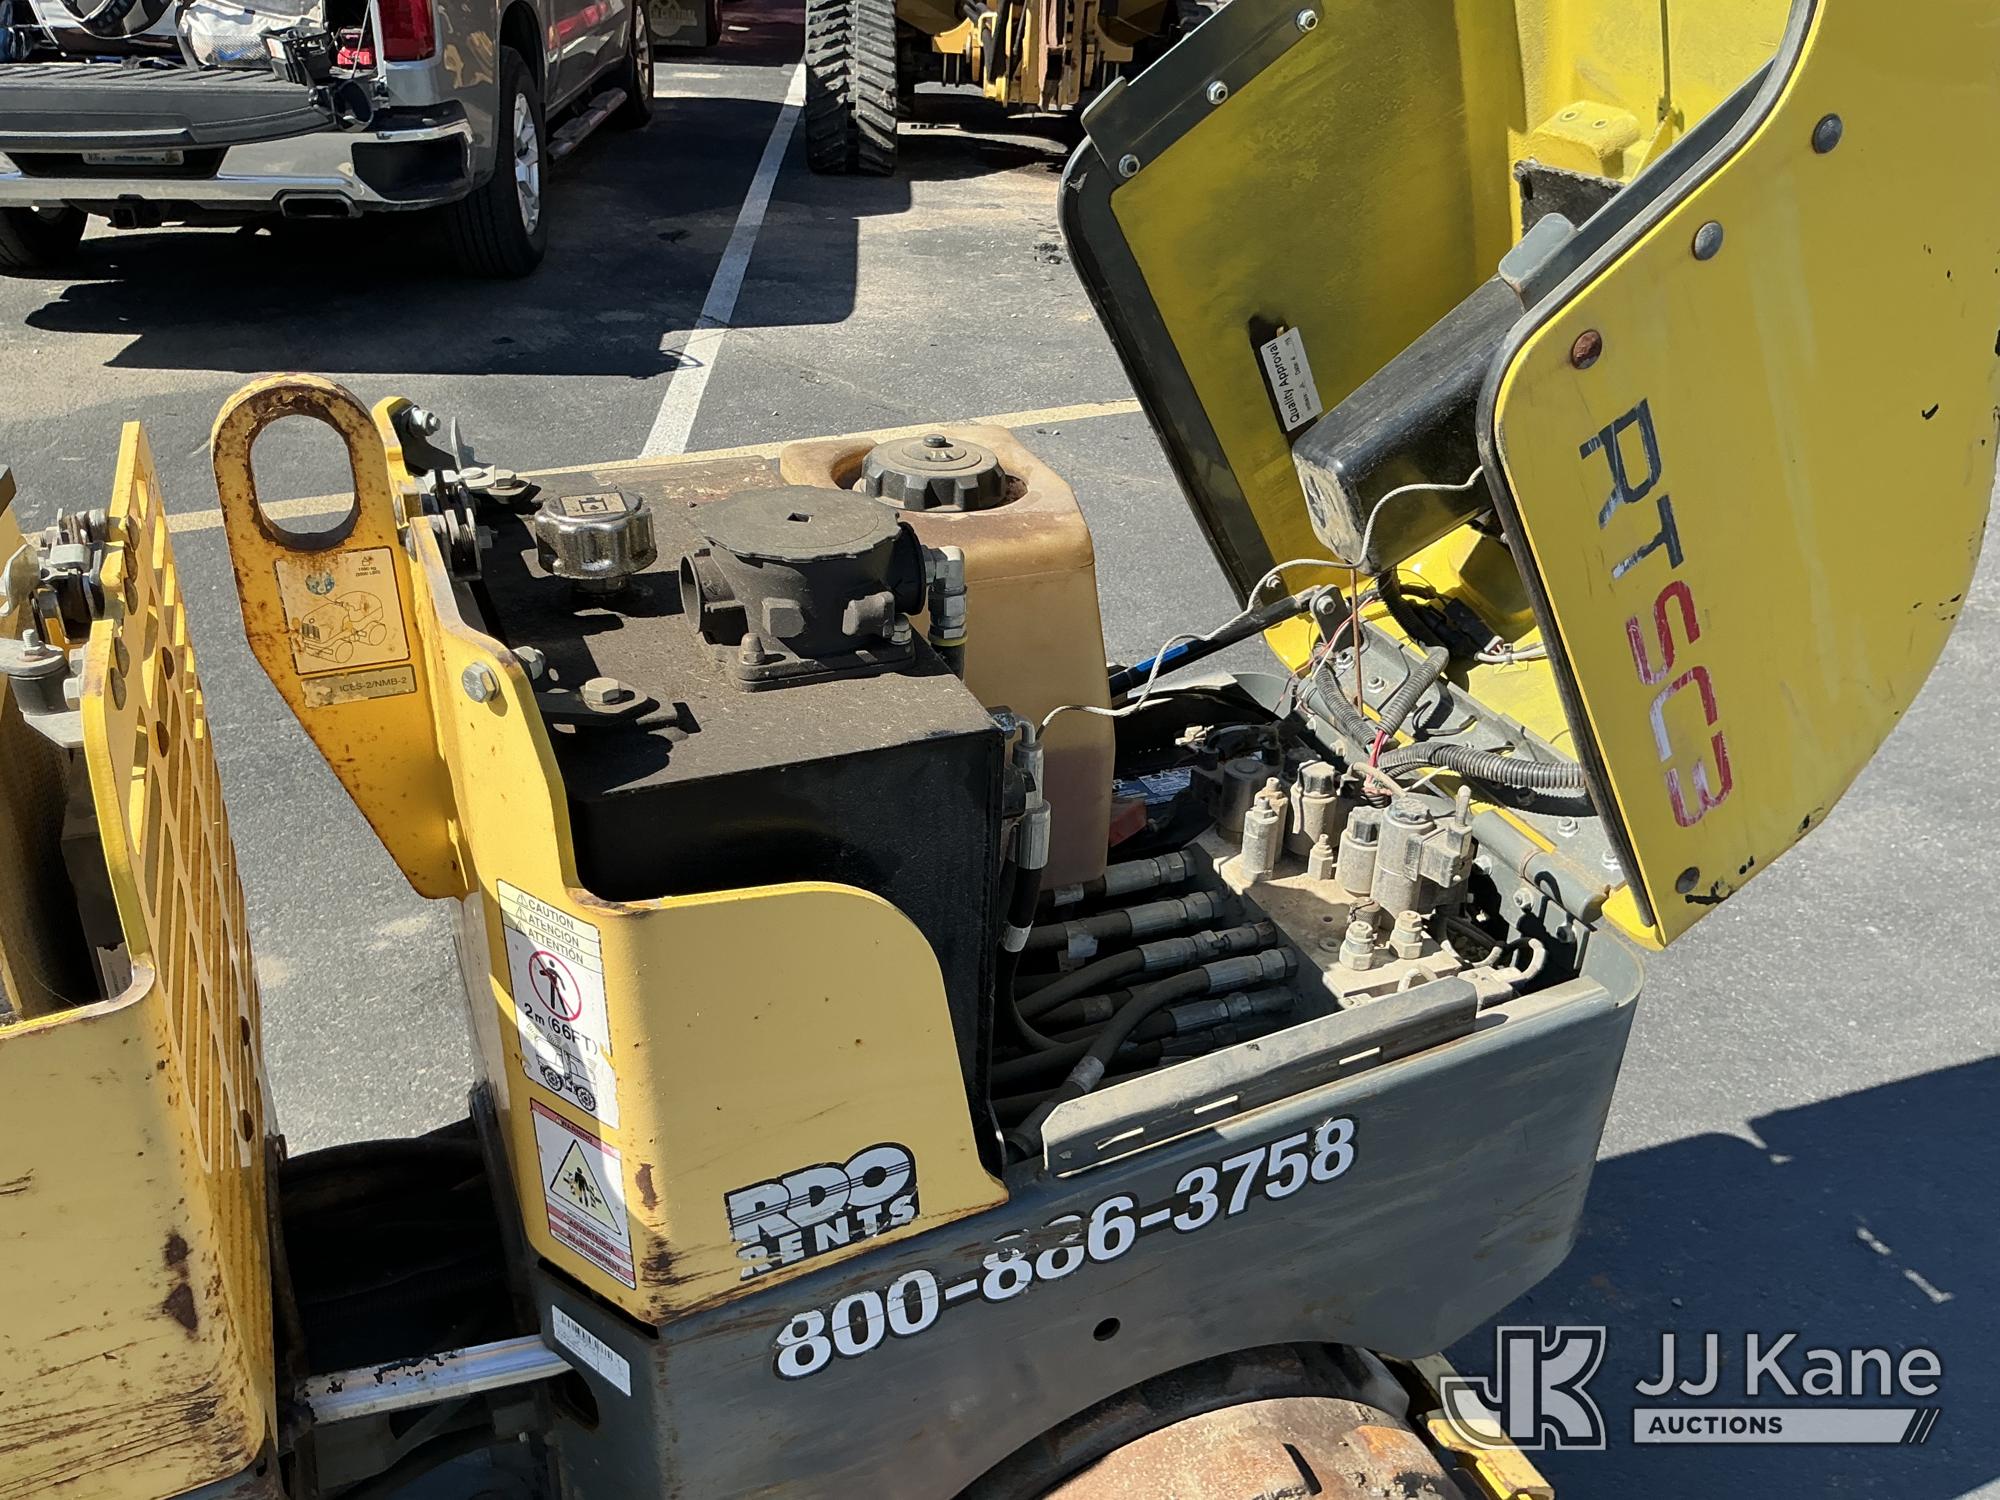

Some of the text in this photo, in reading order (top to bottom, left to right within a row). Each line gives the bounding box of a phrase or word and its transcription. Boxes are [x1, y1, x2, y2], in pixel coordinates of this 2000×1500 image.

[1266, 342, 1301, 424] Quality Approval
[1579, 397, 1733, 828] RTSC3
[339, 676, 407, 693] ICES-2/NMB-2
[528, 899, 574, 930] CAUTION
[727, 1145, 911, 1244] RDO
[736, 1194, 917, 1278] RENTS
